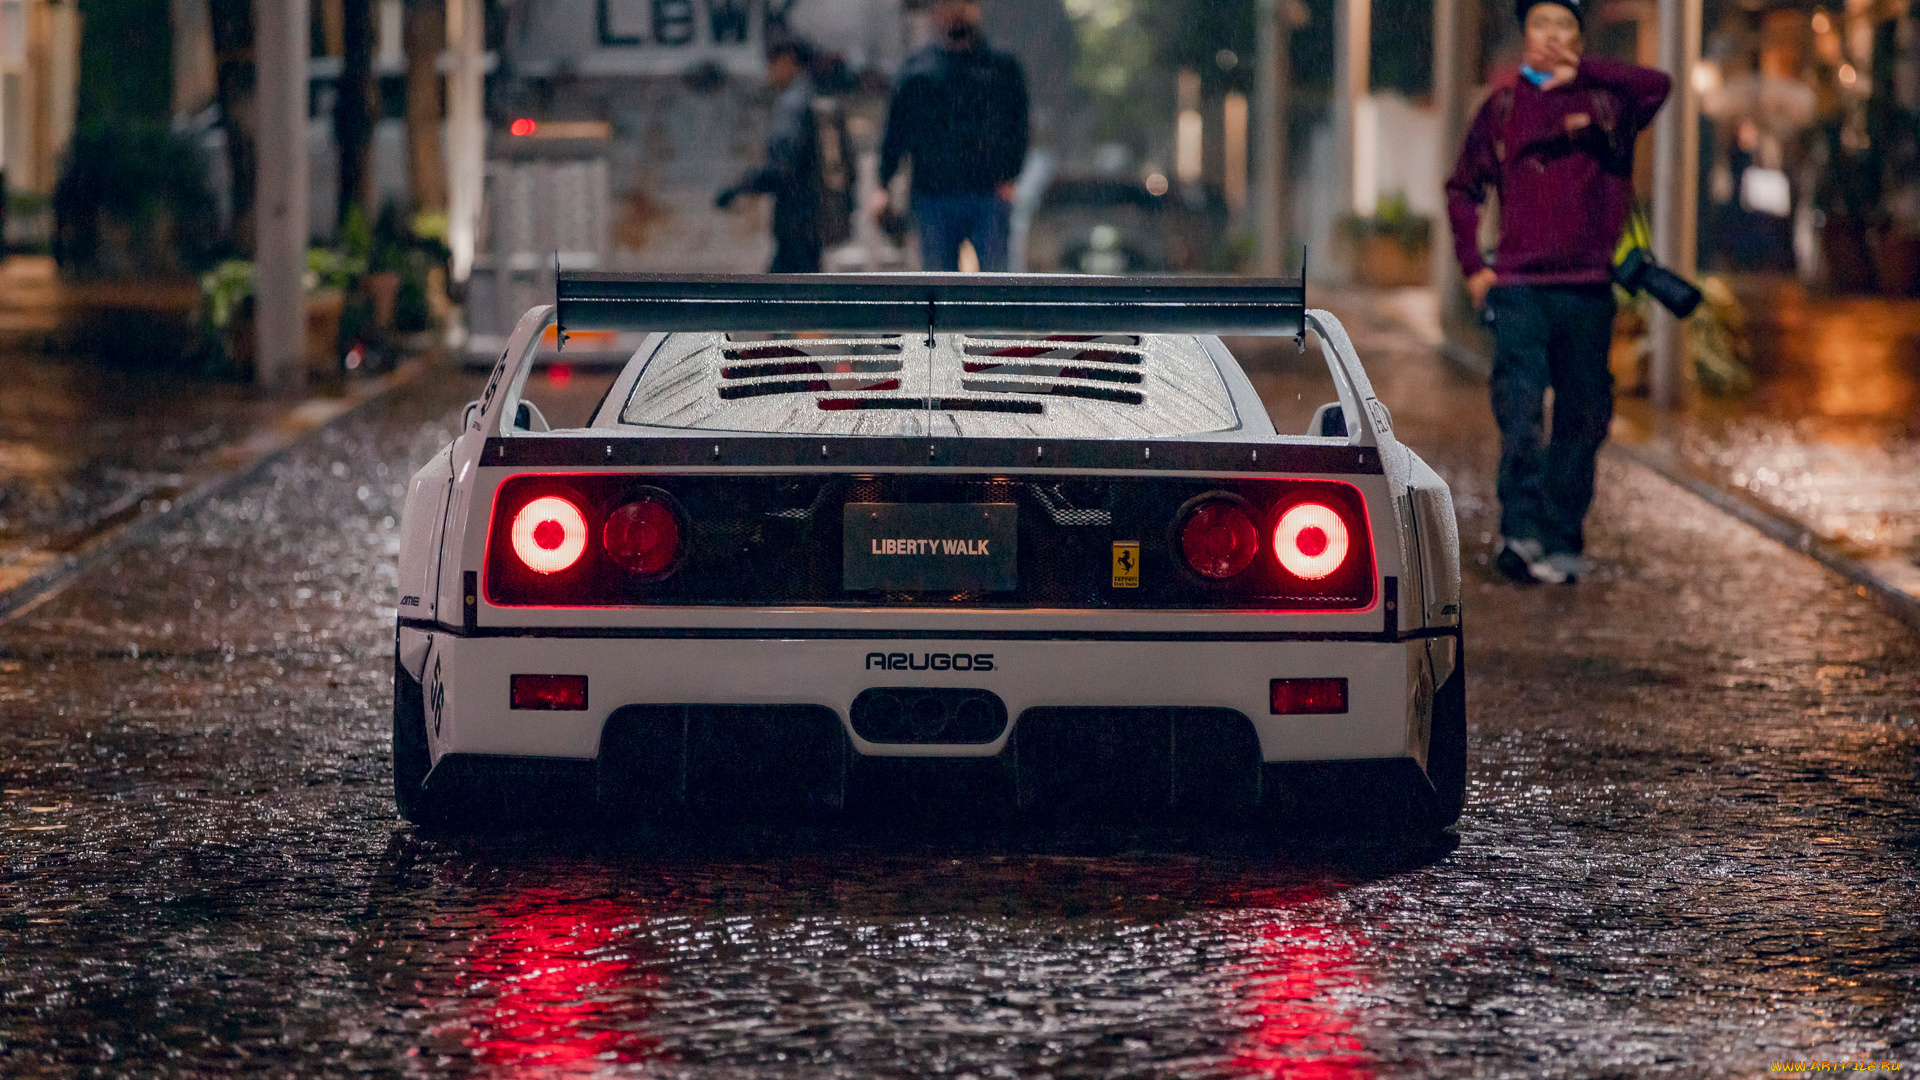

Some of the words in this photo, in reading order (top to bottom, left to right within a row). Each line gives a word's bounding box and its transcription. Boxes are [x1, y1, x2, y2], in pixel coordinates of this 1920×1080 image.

[872, 539, 939, 555] LIBERTY
[942, 539, 989, 555] WALK
[866, 652, 994, 671] ARUGOS
